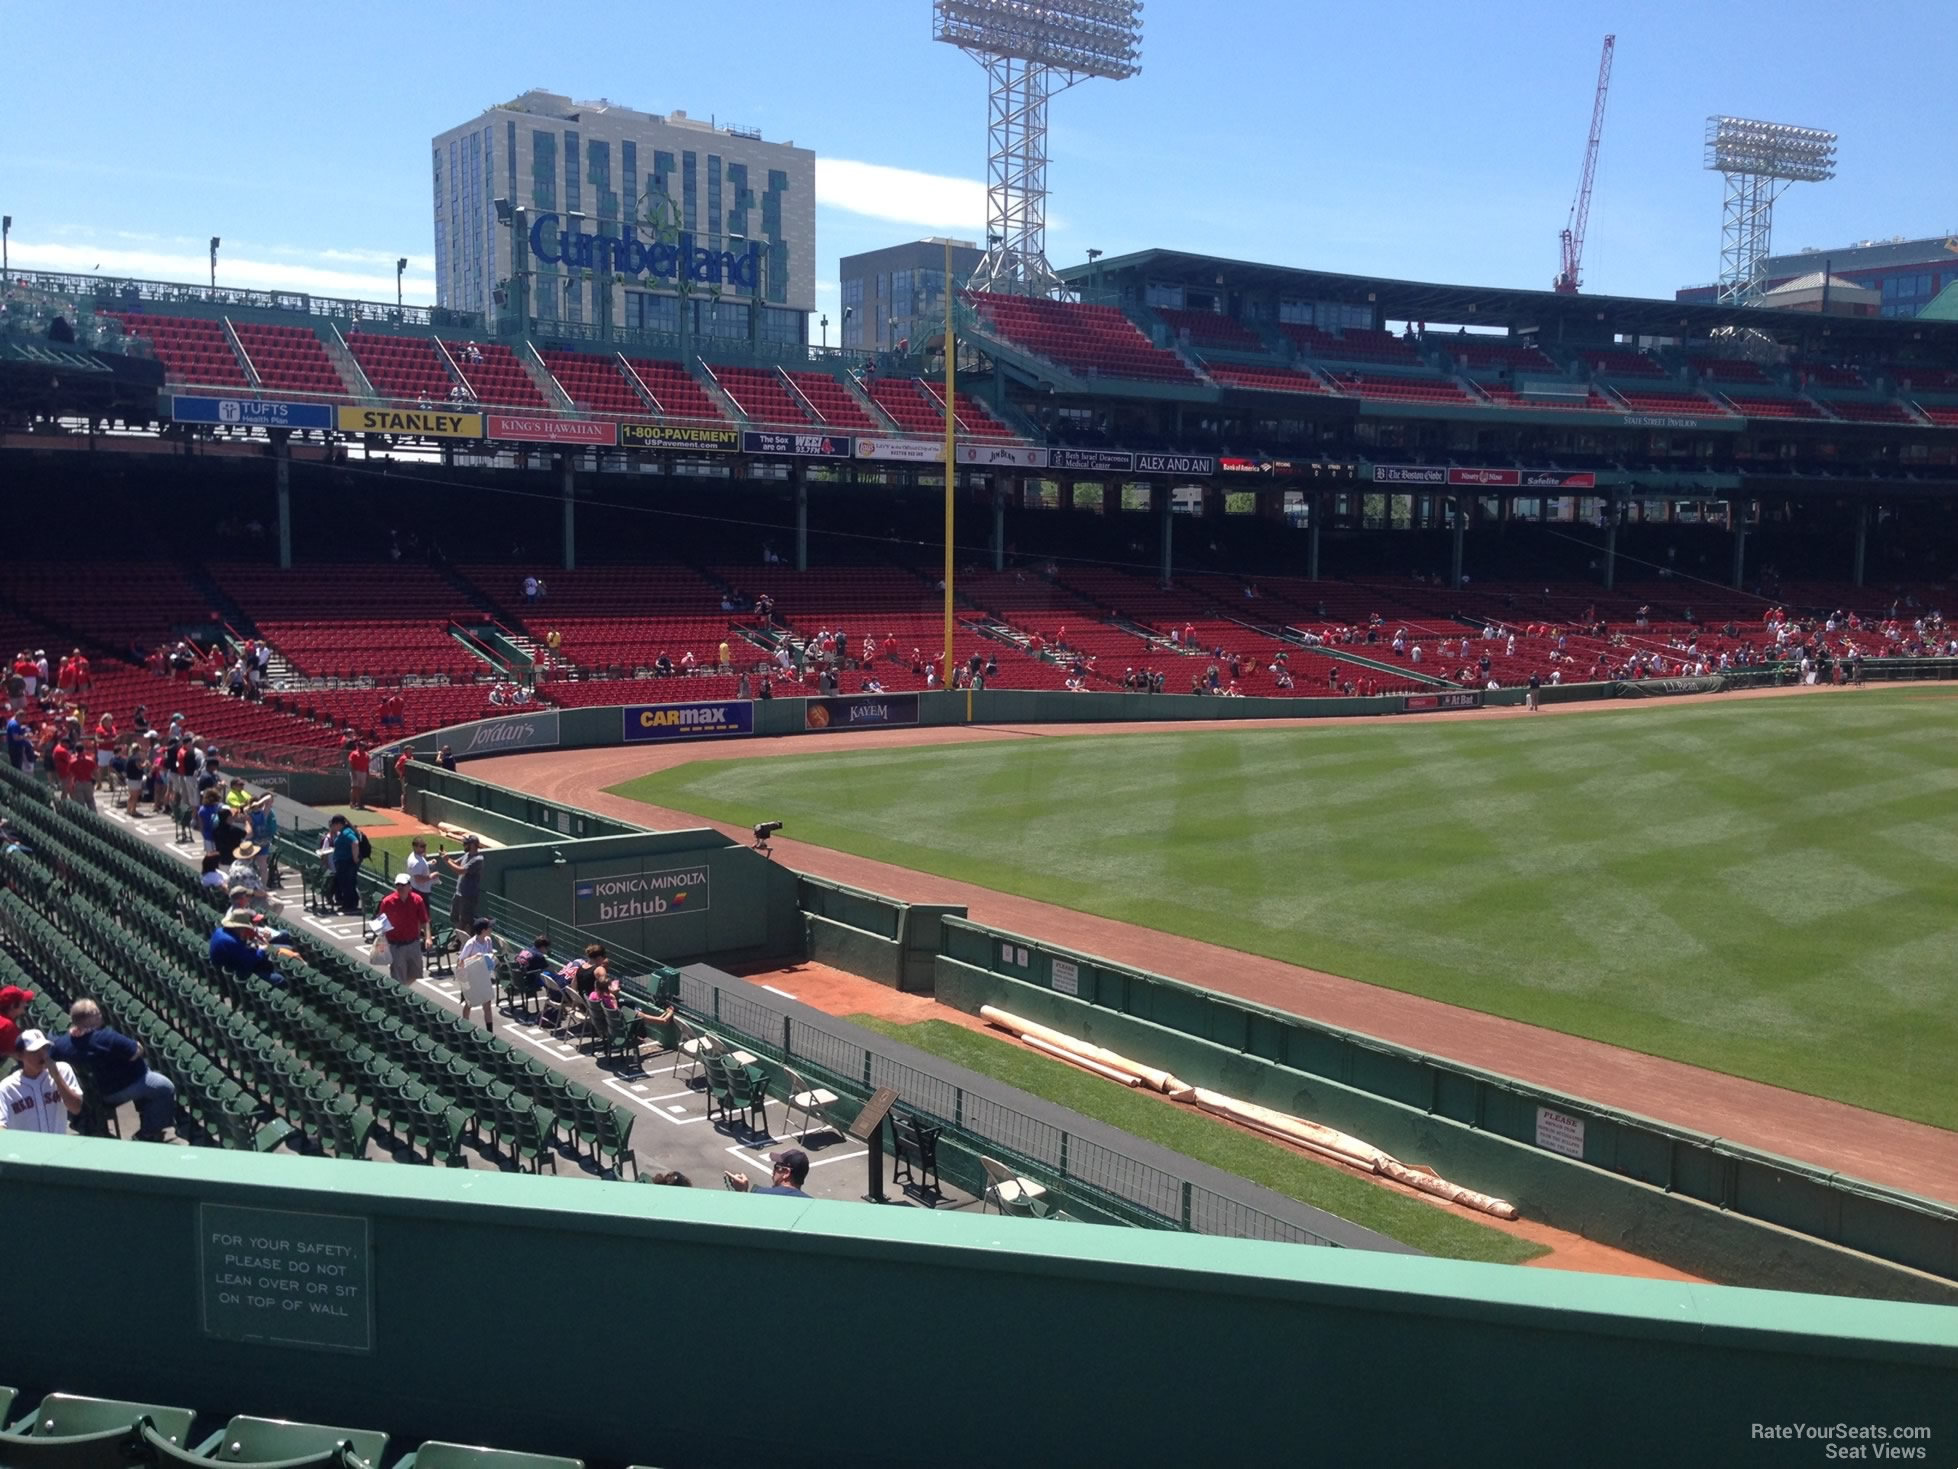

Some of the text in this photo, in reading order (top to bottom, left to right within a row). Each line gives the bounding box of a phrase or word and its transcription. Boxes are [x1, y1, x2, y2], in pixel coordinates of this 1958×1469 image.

[530, 213, 758, 288] Cumberland
[580, 267, 722, 298] FARMS
[241, 402, 288, 416] TUFTS
[242, 415, 269, 424] Health
[363, 412, 462, 432] STANLEY
[501, 420, 602, 435] KING'S HAWAIIAN
[1624, 416, 1697, 427] STATE STREET PAVILION
[624, 426, 737, 443] 1-800-PAVEMENT
[760, 435, 788, 444] The Sox
[644, 439, 718, 449] USPavement.com
[1066, 452, 1129, 462] Beth Israel Deaconess
[1066, 460, 1110, 469] Medical Center
[1140, 457, 1210, 472] ALEX AND ANI
[1388, 470, 1442, 480] The Boston Globe
[1527, 477, 1560, 485] Safelite
[1450, 695, 1473, 705] At Bat
[849, 704, 888, 722] KAYEM
[466, 722, 535, 751] Jordan's
[596, 872, 706, 897] KONICA MINOLTA
[600, 896, 667, 920] bizhub
[11, 1090, 61, 1114] RED SO
[1544, 1112, 1578, 1128] PLEASE
[212, 1233, 242, 1246] FOR
[250, 1237, 290, 1251] YOUR
[225, 1254, 346, 1277] PLEASE DO NOT
[216, 1273, 358, 1297] LEAN OVER OR SIT
[219, 1292, 348, 1316] ON TOP OF WALL
